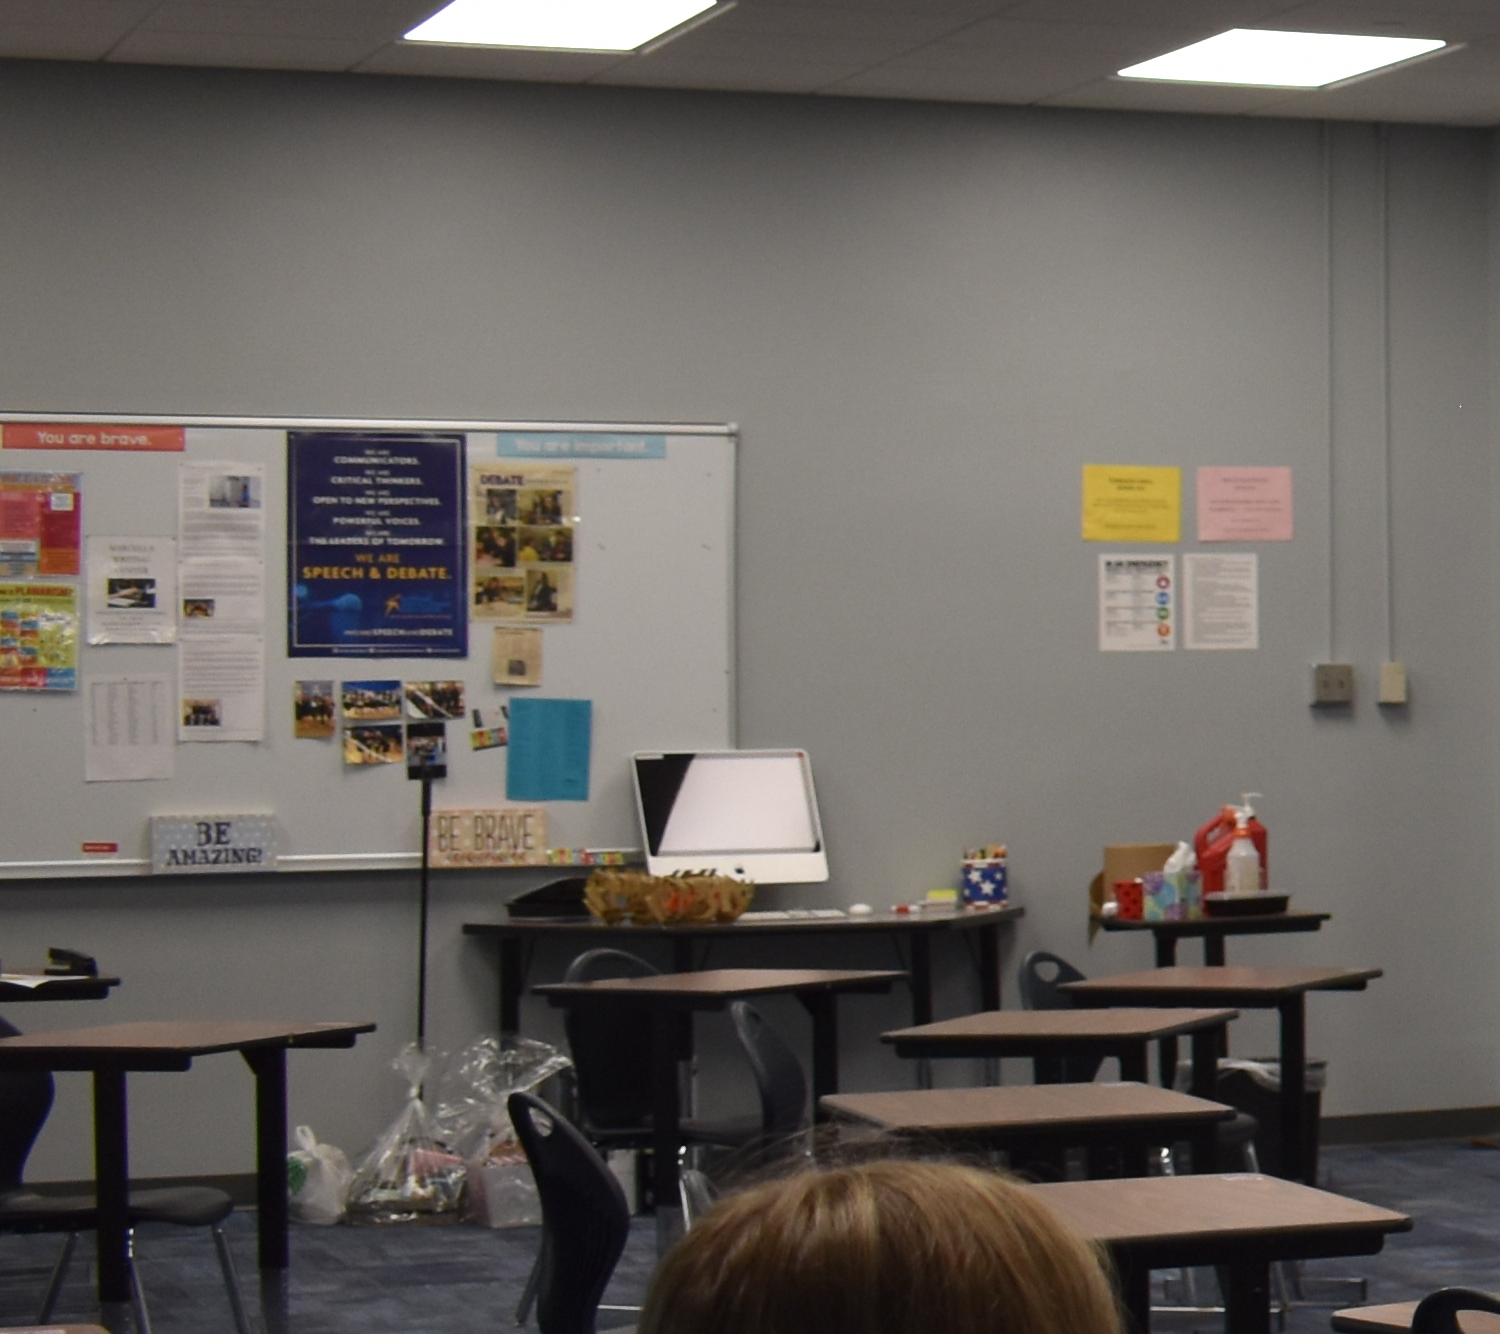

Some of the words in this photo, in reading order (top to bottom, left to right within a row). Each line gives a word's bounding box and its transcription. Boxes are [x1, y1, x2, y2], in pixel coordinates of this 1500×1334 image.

[38, 431, 64, 445] You
[68, 434, 96, 445] are
[100, 432, 152, 446] brave.
[330, 476, 373, 486] CRITICAL
[480, 473, 523, 485] DEBATE
[312, 496, 338, 505] OPEN
[340, 496, 353, 505] TO
[355, 496, 376, 505] NEW
[332, 516, 383, 526] POWERFUL
[371, 537, 384, 546] OF
[355, 553, 374, 564] WE
[378, 553, 400, 564] ARE
[302, 567, 364, 580] SPEECH
[368, 567, 381, 580] &
[386, 567, 452, 580] DEBATE.
[195, 822, 232, 847] BE
[437, 813, 462, 853] BE
[473, 813, 534, 852] BRAVE
[166, 847, 262, 867] AMAZING!
